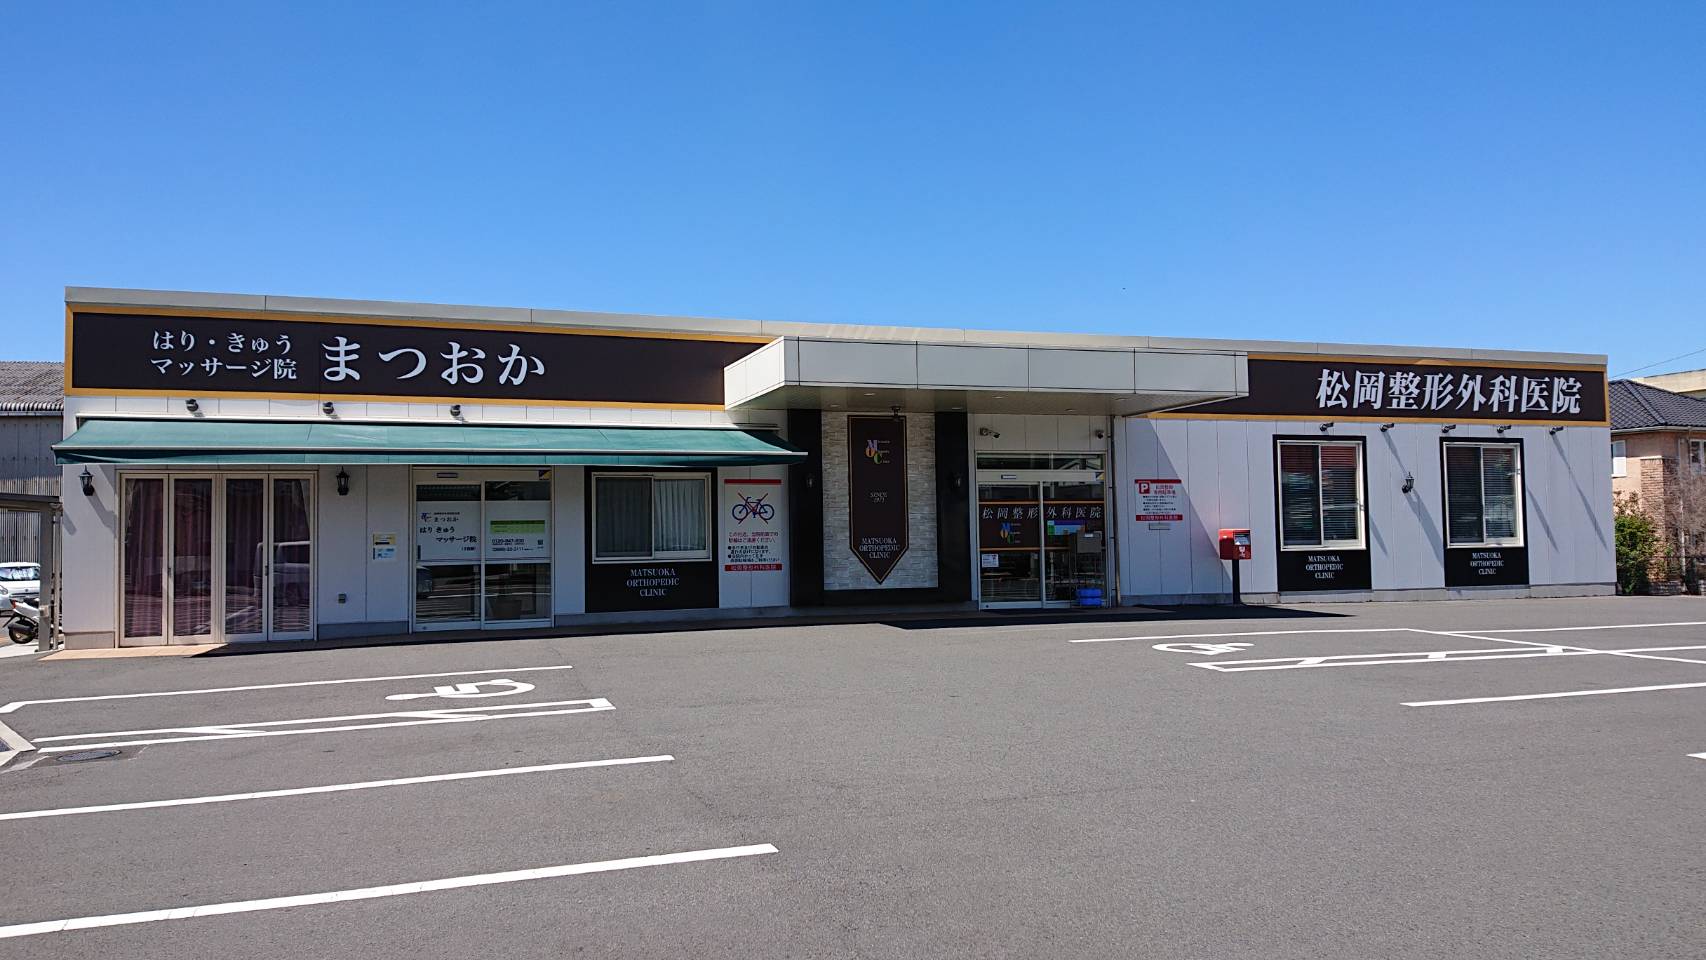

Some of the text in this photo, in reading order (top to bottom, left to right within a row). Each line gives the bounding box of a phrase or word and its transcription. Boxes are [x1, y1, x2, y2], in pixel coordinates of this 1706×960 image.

[153, 330, 292, 354] はり・きゅう
[321, 336, 545, 386] まつおか
[151, 357, 297, 380] マッサージ院
[1316, 368, 1582, 414] 松岡整形外科医院
[1140, 483, 1149, 493] P
[982, 506, 1102, 519] 松岡整形 外科医院
[631, 568, 676, 577] MATSUOKA
[627, 578, 679, 587] ORTHOPEDIC
[640, 588, 667, 597] CLINIC
